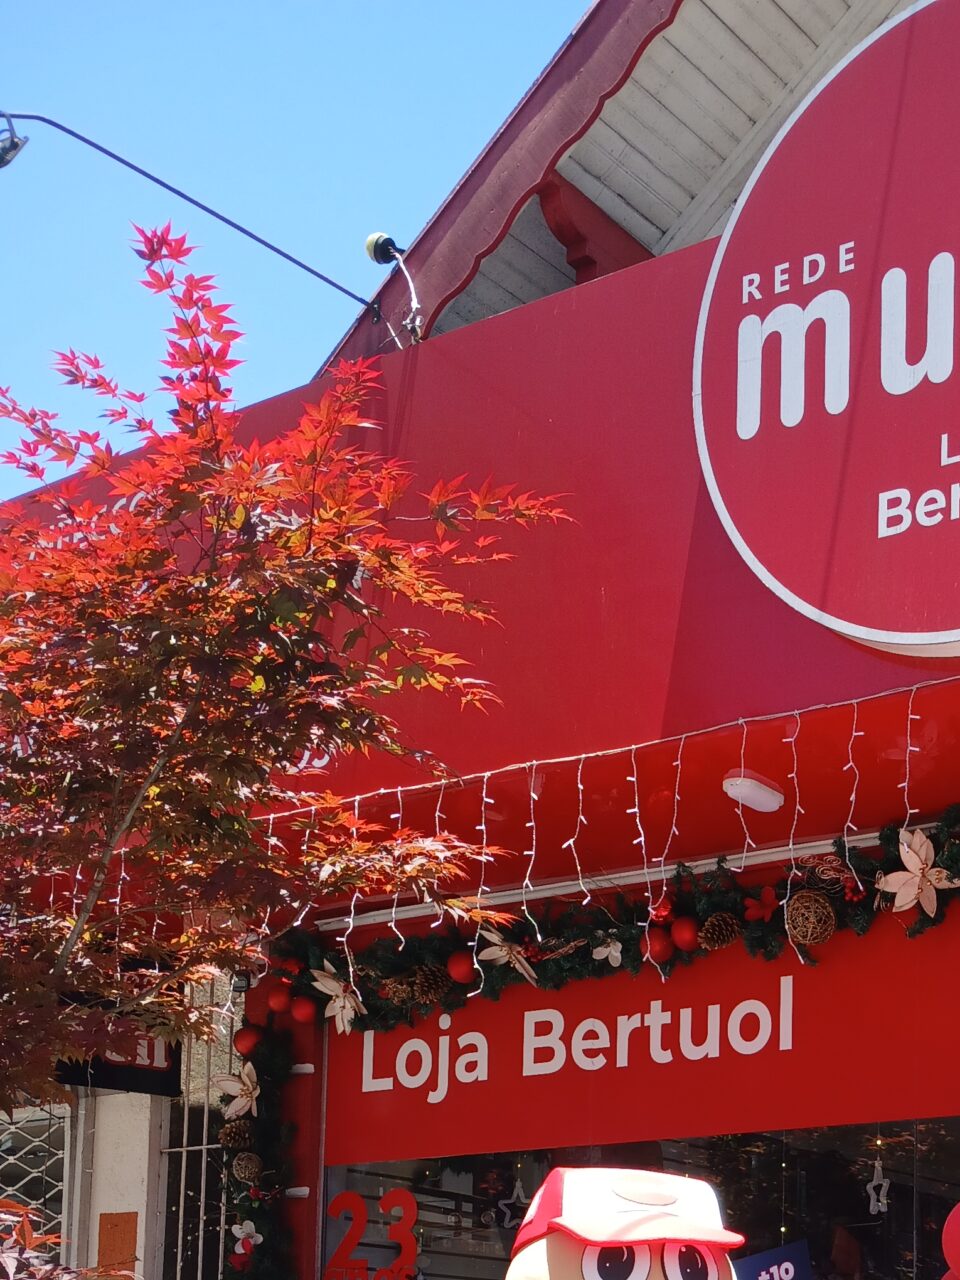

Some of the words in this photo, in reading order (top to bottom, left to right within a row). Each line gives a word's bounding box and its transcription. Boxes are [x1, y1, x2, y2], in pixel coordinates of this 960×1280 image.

[742, 240, 855, 304] REDE
[361, 1013, 489, 1104] Loja
[522, 975, 794, 1078] Bertuol
[327, 1187, 418, 1274] 23
